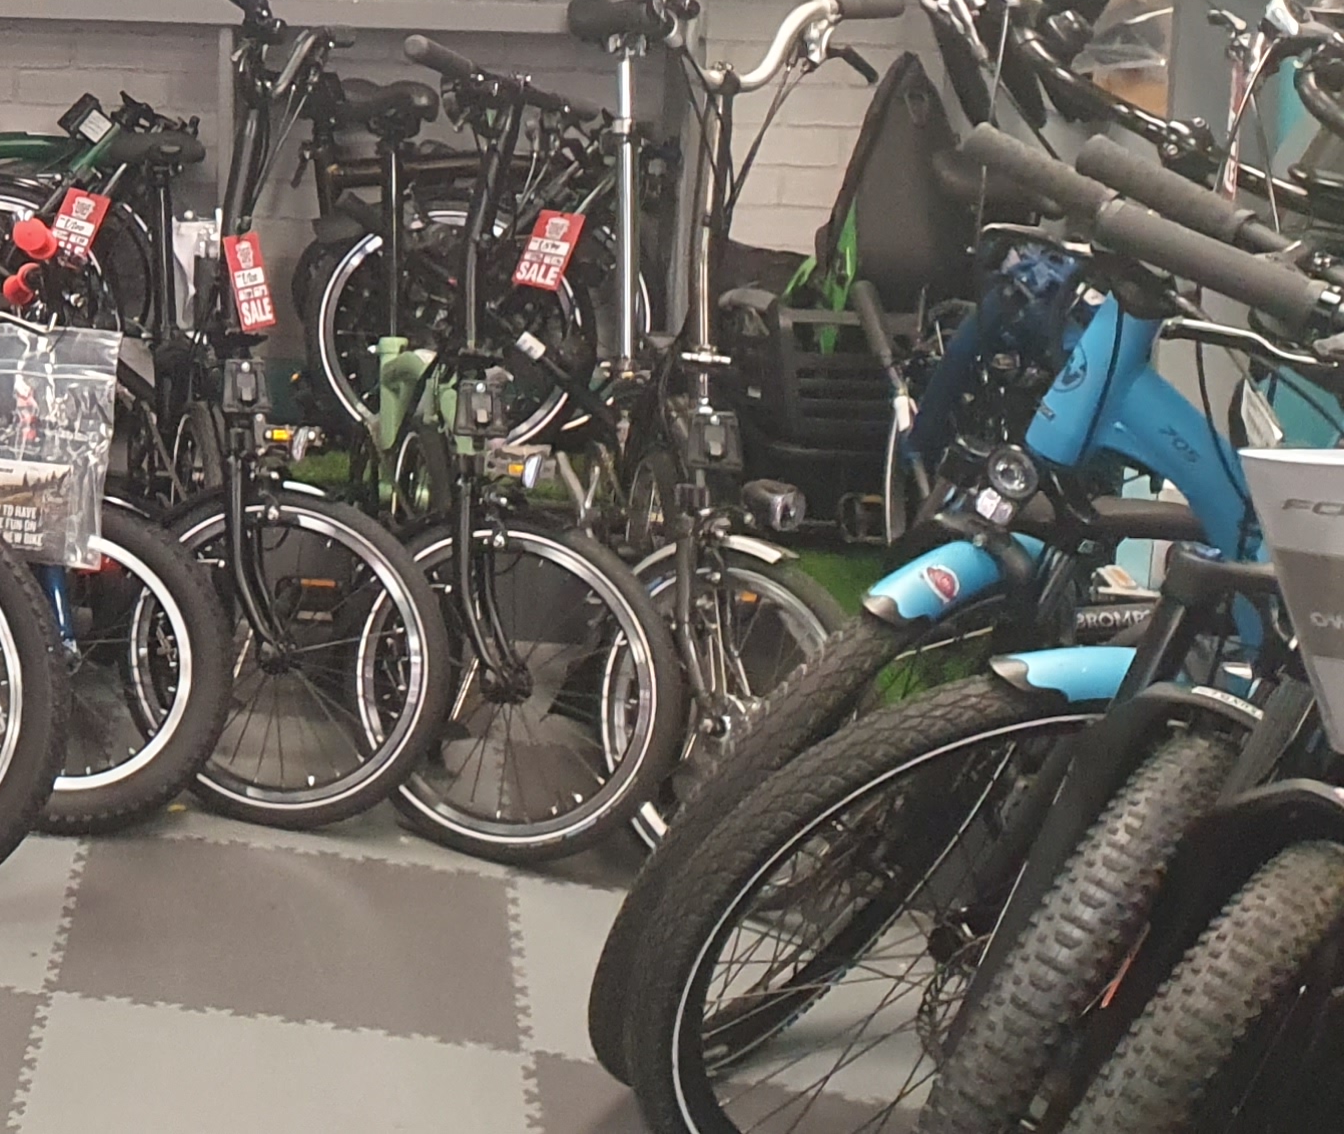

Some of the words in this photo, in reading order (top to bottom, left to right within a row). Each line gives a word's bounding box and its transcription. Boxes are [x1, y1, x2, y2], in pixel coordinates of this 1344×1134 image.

[515, 261, 561, 286] SALE
[241, 297, 274, 326] SALE
[14, 505, 38, 520] HAVE
[1076, 609, 1150, 629] BROMP
